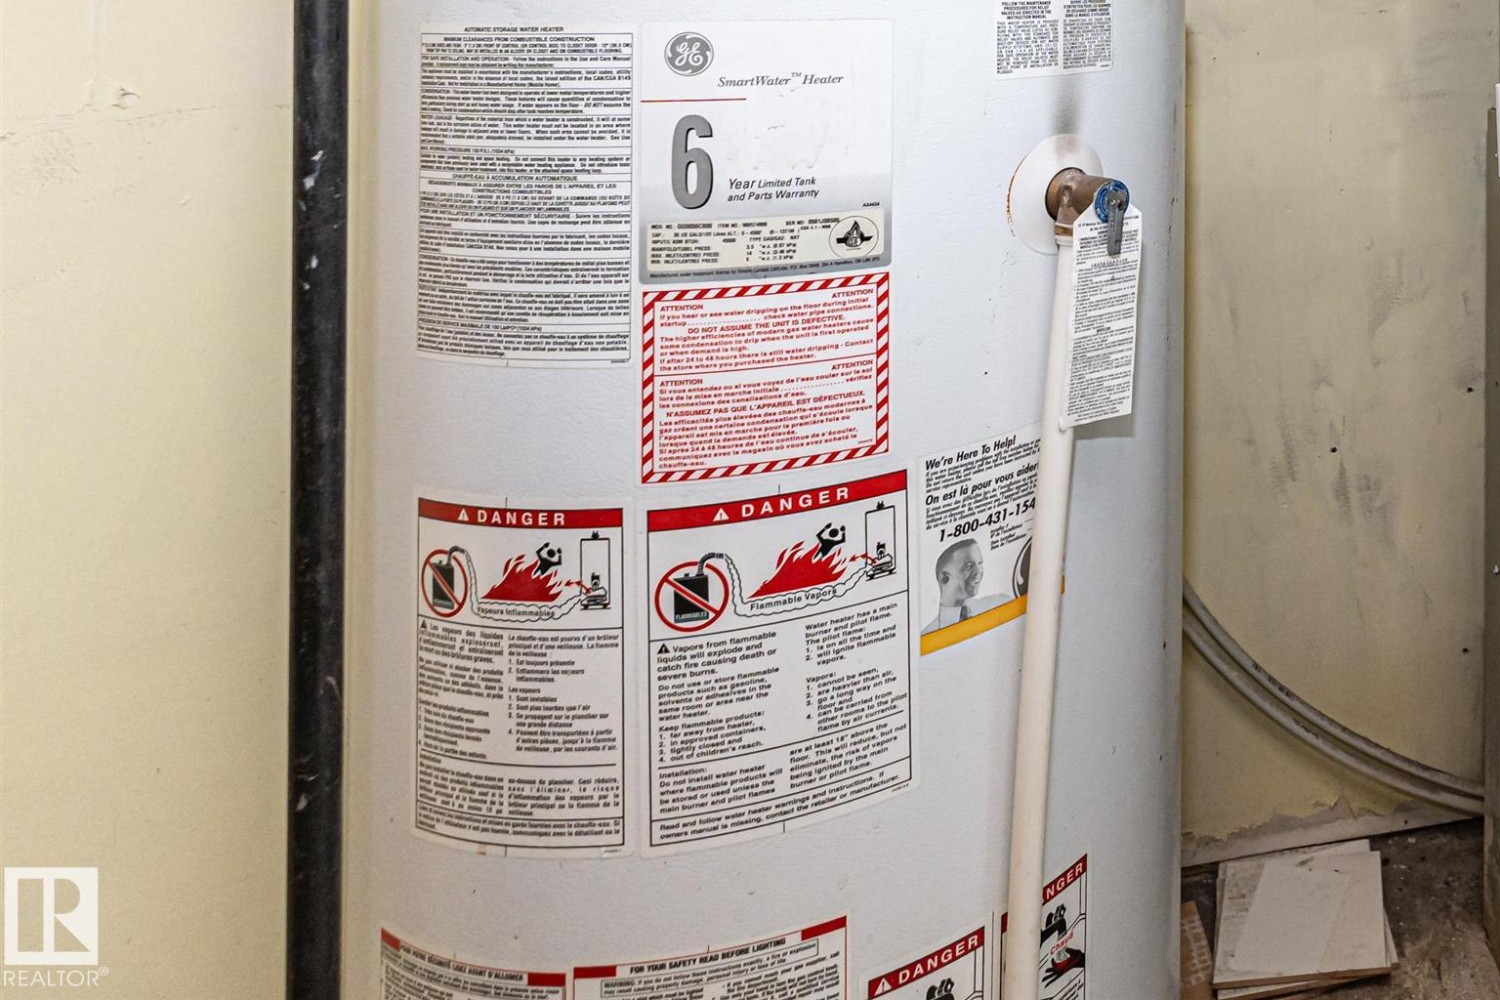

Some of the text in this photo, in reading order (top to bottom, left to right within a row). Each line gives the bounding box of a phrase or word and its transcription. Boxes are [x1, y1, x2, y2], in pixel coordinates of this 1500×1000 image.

[802, 75, 844, 85] Heater
[671, 114, 714, 209] 6
[729, 176, 816, 190] Year Limited Tank
[727, 188, 819, 202] and Parts Warranty
[832, 289, 873, 298] ATTENTION
[720, 324, 752, 332] ASSUME
[801, 315, 845, 324] DEFECTIVE.
[831, 360, 873, 370] ATTENTION
[666, 409, 711, 417] N'ASSUMEZ
[731, 405, 747, 413] QUE
[749, 401, 794, 410] L'APPAREIL
[813, 391, 865, 403] DÉFECTUEUX.
[925, 434, 1017, 470] We're Here To Help!
[925, 494, 939, 505] On
[942, 489, 957, 501] est
[959, 484, 969, 496] là
[971, 480, 992, 494] pour
[995, 471, 1014, 484] vous
[741, 486, 849, 517] DANGER
[477, 510, 566, 526] DANGER
[940, 496, 1037, 542] 1-800-431-154
[750, 588, 837, 612] Flammable Vapors
[805, 621, 828, 630] Water
[830, 615, 855, 624] heater
[880, 603, 898, 611] main
[805, 628, 832, 638] burner
[850, 619, 868, 628] pilot
[870, 613, 893, 622] flame.
[673, 644, 704, 653] Vapors
[729, 631, 777, 644] flammable
[805, 638, 820, 646] The
[822, 634, 840, 643] pilot
[657, 642, 762, 664] liquids will explode and
[657, 662, 682, 672] catch
[684, 661, 699, 669] fire
[701, 656, 737, 667] causing
[739, 651, 765, 661] death
[657, 669, 718, 681] severe burns.
[714, 676, 735, 684] store
[737, 667, 779, 679] flammable
[658, 689, 694, 699] products
[697, 685, 716, 694] such
[1045, 861, 1083, 900] NGER
[1050, 931, 1074, 956] Chaud
[630, 937, 786, 974] FOR YOUR SAFETY READ BEFORE LIGHTING
[898, 934, 978, 985] DANGER
